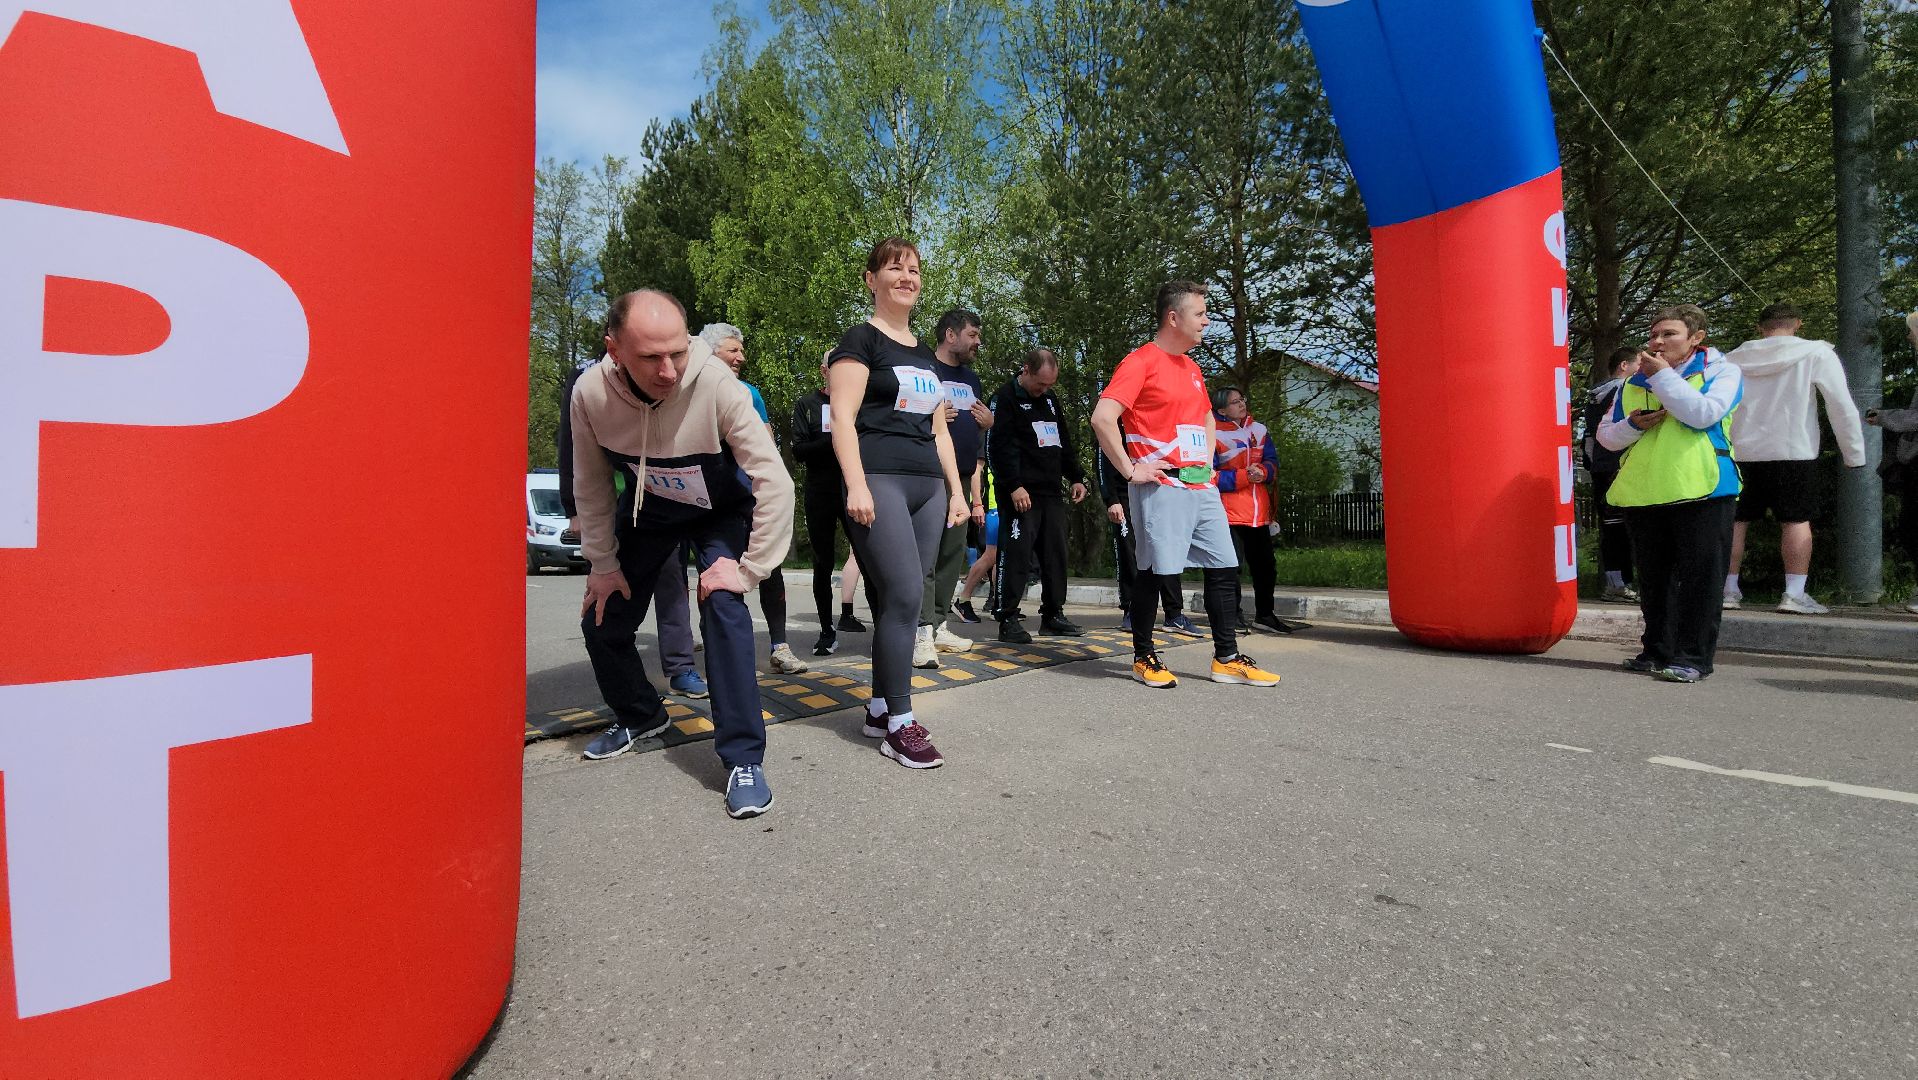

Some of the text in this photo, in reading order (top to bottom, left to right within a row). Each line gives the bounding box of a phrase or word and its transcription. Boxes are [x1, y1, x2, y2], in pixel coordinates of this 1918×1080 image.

[914, 376, 936, 394] 116
[951, 387, 968, 399] 109
[1192, 433, 1206, 447] 11
[648, 474, 686, 490] 113
